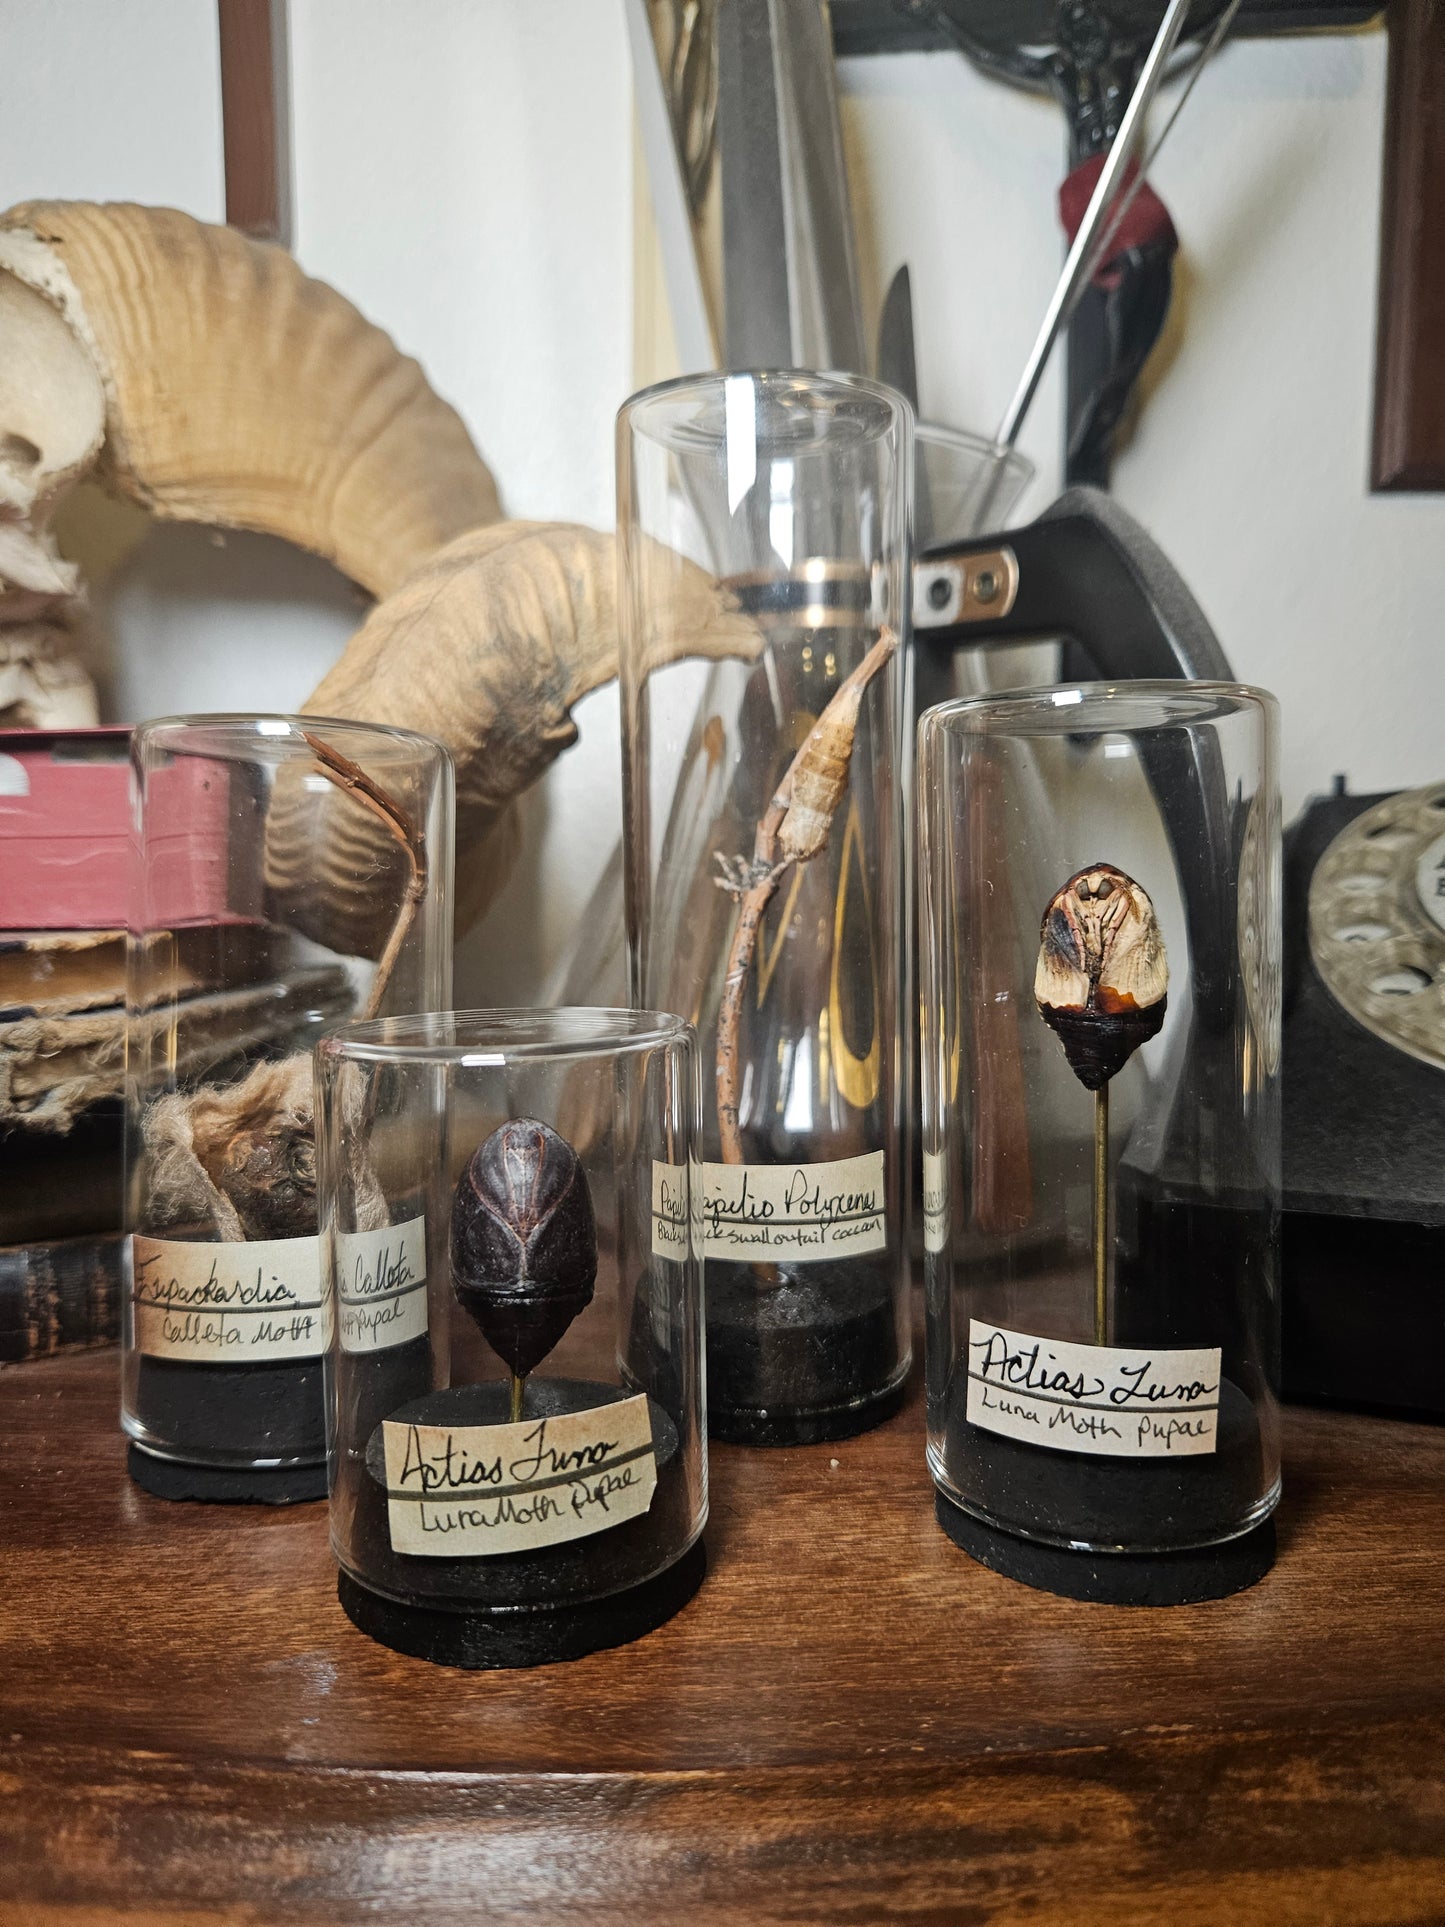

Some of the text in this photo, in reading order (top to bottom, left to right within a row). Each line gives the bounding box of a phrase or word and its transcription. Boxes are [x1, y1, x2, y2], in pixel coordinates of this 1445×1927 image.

[969, 1331, 1218, 1404] Actias Luna
[982, 1387, 1040, 1424] Luna
[1049, 1406, 1121, 1439] Moth
[400, 1424, 503, 1493] Actias
[420, 1502, 494, 1533] Luna
[494, 1496, 565, 1524] Moth
